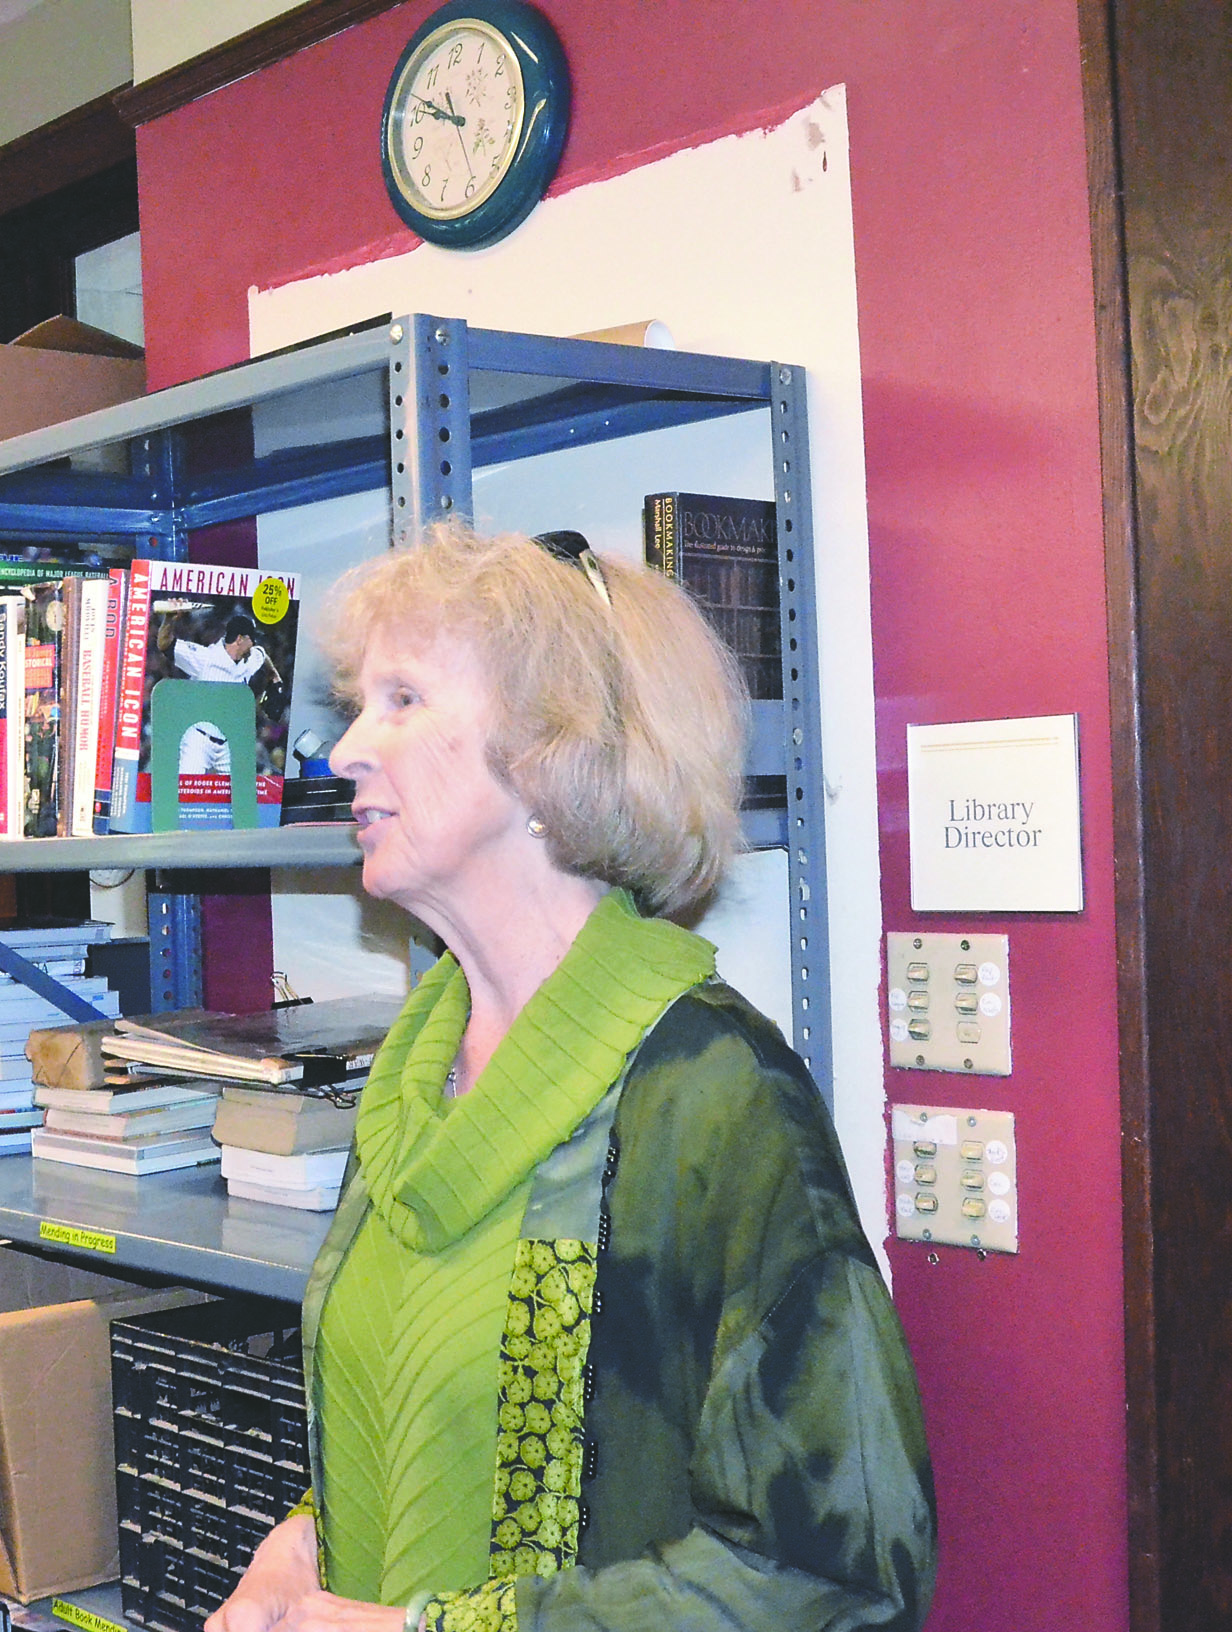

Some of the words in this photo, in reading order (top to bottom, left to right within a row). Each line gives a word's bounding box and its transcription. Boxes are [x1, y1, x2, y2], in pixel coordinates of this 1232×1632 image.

[447, 43, 463, 70] 12
[476, 42, 486, 64] 1
[426, 64, 440, 90] 11
[494, 54, 507, 78] 2
[504, 85, 518, 110] 3
[410, 101, 426, 127] 10
[411, 136, 424, 160] 9
[421, 164, 432, 187] 8
[488, 155, 501, 180] 5
[440, 178, 450, 203] 7
[464, 175, 477, 200] 6
[664, 497, 675, 577] BOOKMAKING
[45, 570, 64, 578] MAJOR
[64, 571, 83, 579] LEAGUE
[160, 567, 249, 597] AMERICAN
[263, 584, 282, 596] 25%
[265, 596, 278, 605] OFF
[126, 573, 149, 678] AMERICAN
[80, 649, 92, 706] BASEBALL
[121, 689, 140, 738] ICON
[79, 710, 90, 751] HUMOR
[949, 799, 1034, 825] Library
[944, 826, 1043, 849] Director
[41, 1224, 70, 1243] Mending
[81, 1231, 113, 1249] Progress
[75, 1607, 93, 1625] Book
